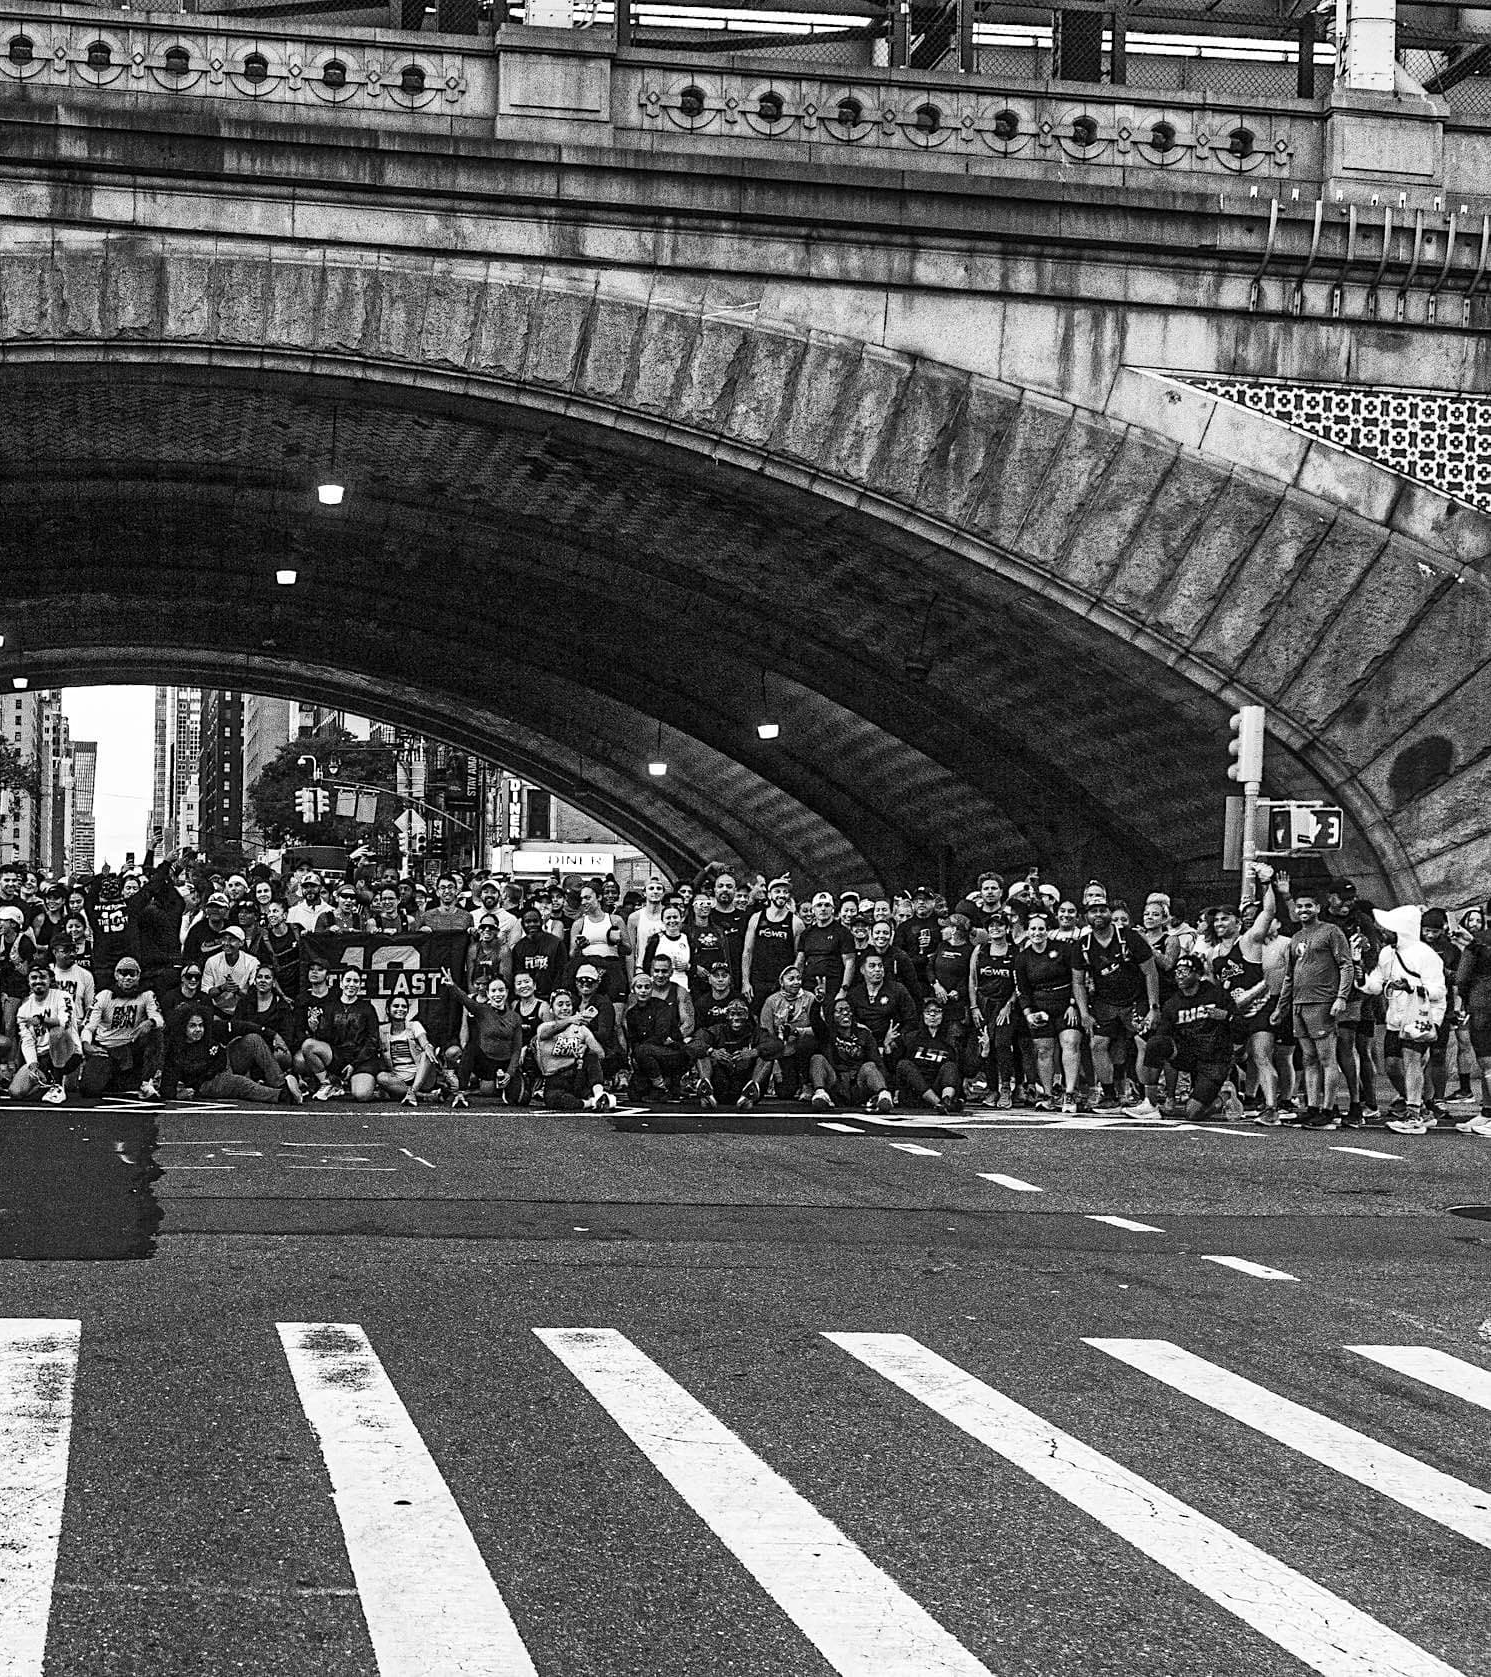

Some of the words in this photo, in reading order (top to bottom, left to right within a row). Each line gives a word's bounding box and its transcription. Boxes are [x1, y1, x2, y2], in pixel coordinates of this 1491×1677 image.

[467, 775, 477, 797] STAY
[509, 779, 521, 838] DINER
[979, 966, 1011, 978] POWER
[327, 974, 368, 996] TE
[378, 973, 442, 996] LAST
[114, 1005, 138, 1016] RUN
[111, 1020, 136, 1030] RUN
[555, 1037, 578, 1048] RUN
[552, 1047, 579, 1058] RUN
